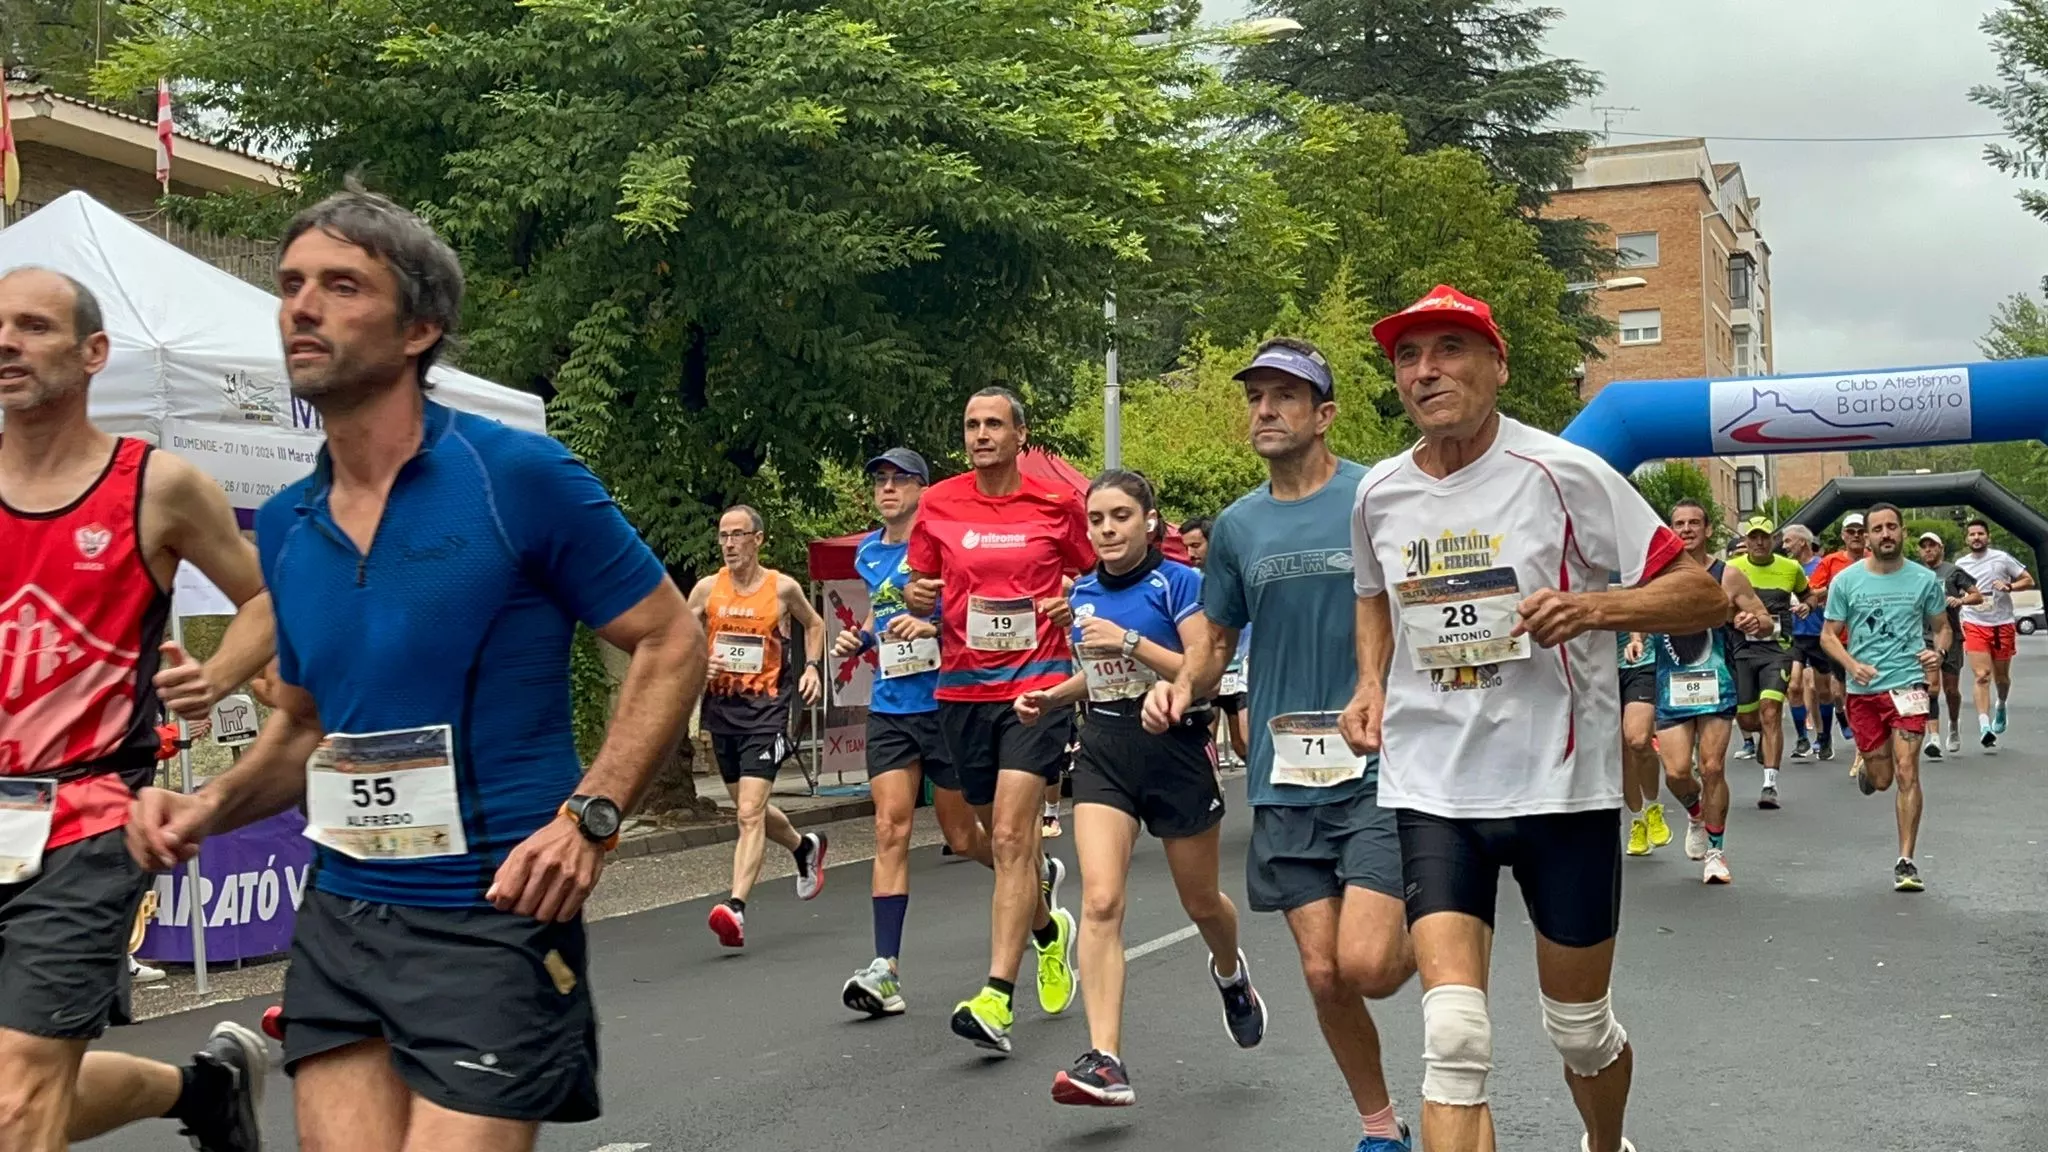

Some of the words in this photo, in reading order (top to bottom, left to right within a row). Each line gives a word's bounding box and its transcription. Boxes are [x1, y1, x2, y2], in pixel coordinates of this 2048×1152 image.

[1836, 379, 1877, 392] Club
[1882, 374, 1962, 389] Atletismo
[1837, 391, 1962, 415] Barbastro
[173, 435, 218, 453] DIUMENGE
[1406, 538, 1430, 577] 20
[1444, 552, 1492, 570] BERBEGAL
[991, 617, 1012, 629] 19
[1442, 604, 1478, 628] 28
[1438, 629, 1492, 644] ANTONIO
[730, 647, 745, 657] 26
[897, 643, 914, 656] 31
[1093, 658, 1137, 677] 1012
[1480, 676, 1503, 689] 2010
[1686, 682, 1700, 691] 68
[1302, 738, 1325, 755] 71
[351, 777, 396, 808] 55
[346, 813, 413, 827] ALFREDO
